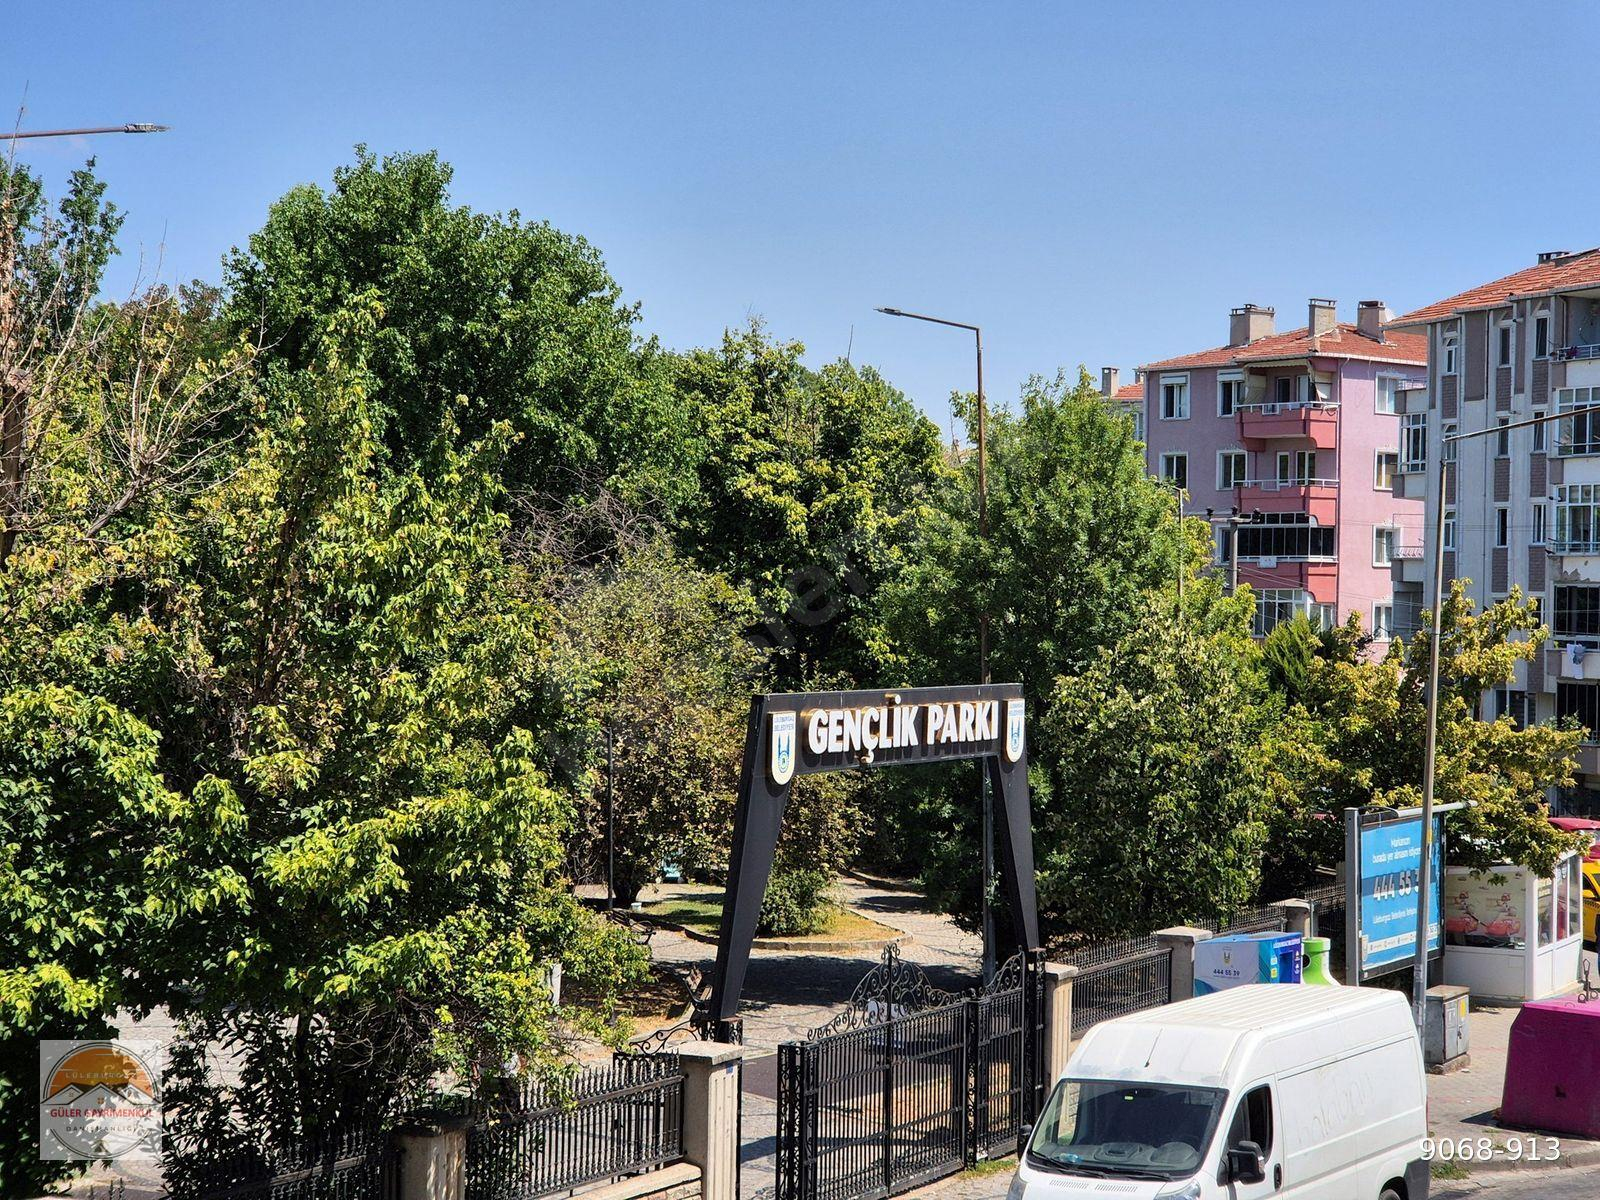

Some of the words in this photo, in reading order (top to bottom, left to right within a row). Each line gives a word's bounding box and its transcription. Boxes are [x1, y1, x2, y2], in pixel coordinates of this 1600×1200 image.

[808, 694, 919, 763] GENÇLİK
[926, 700, 999, 746] PARKI
[1374, 875, 1395, 901] 444
[1399, 870, 1412, 897] 55
